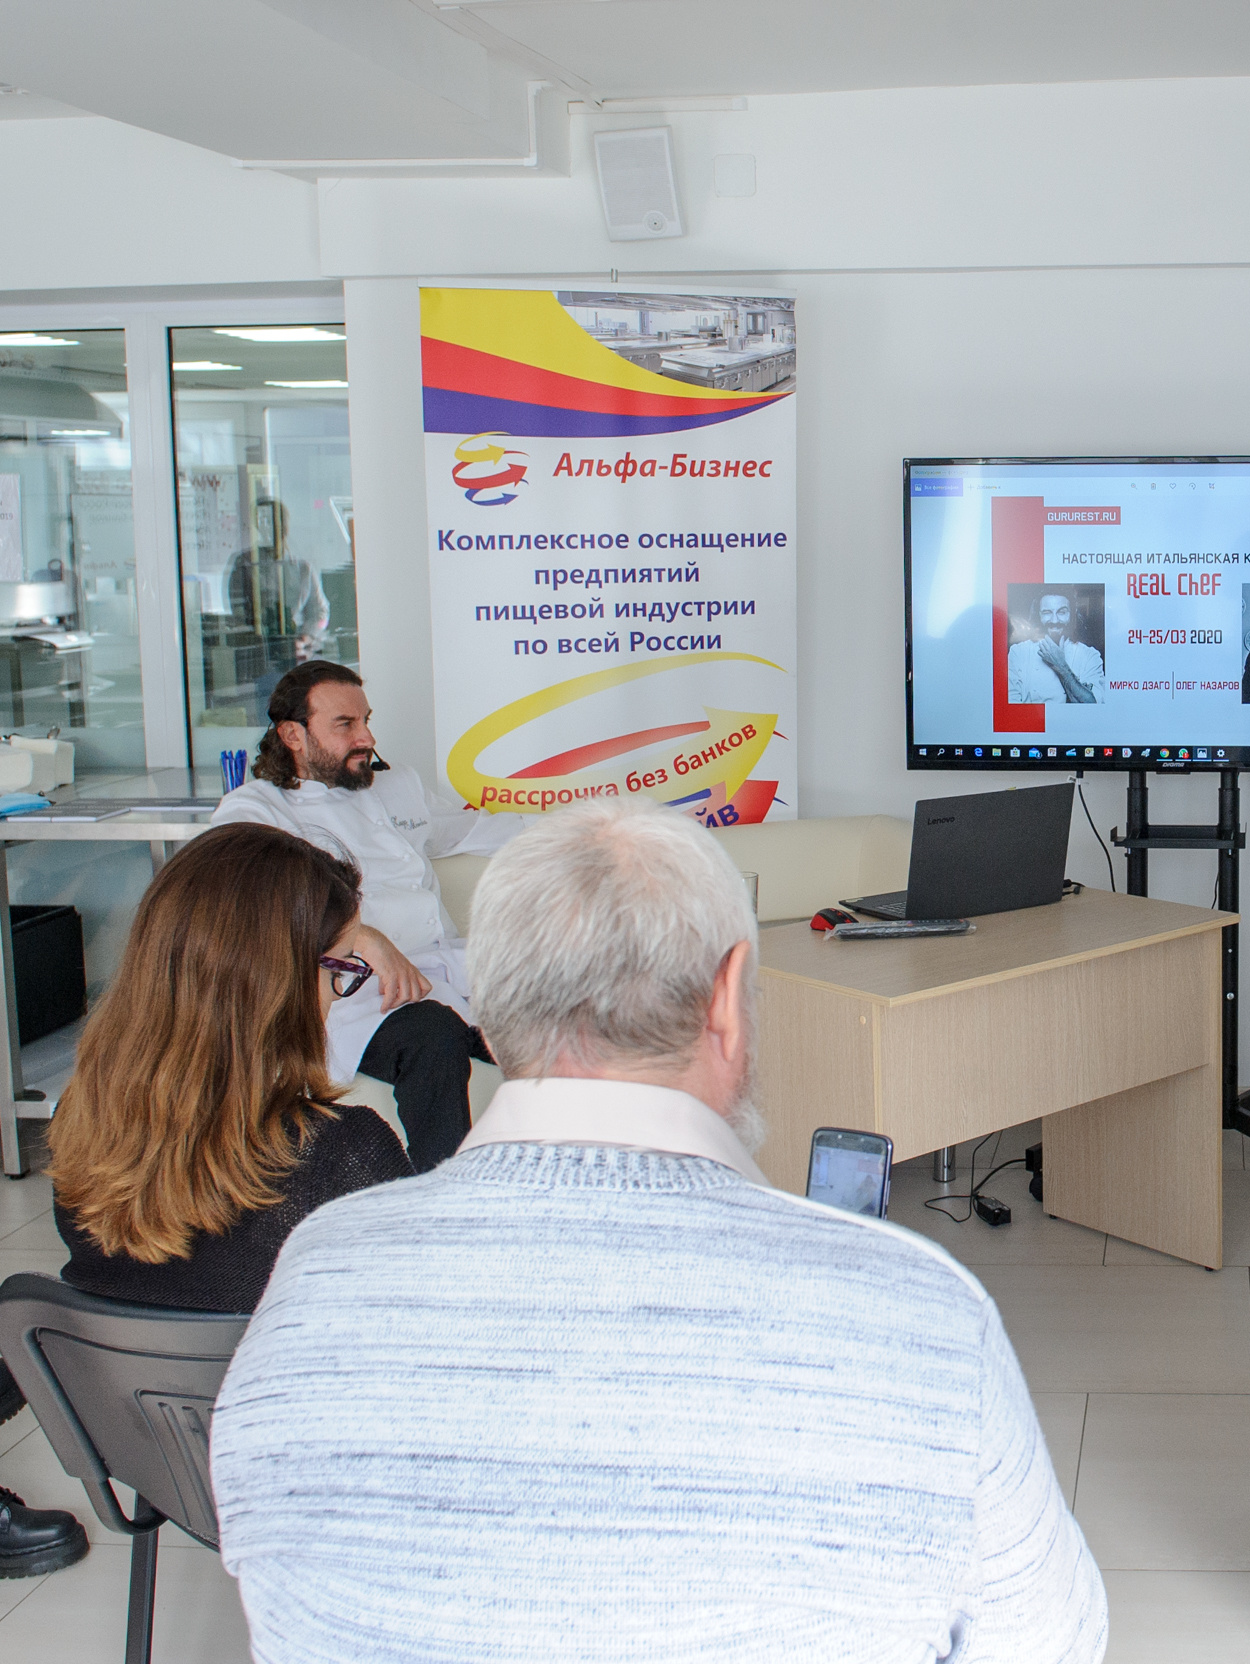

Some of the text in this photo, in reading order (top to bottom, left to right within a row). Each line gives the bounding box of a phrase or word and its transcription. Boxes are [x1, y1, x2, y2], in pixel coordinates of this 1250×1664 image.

[553, 452, 773, 484] Альфа-Бизнес
[1047, 511, 1117, 522] GURUREST.RU
[437, 529, 788, 553] Комплексное оснащение
[1062, 553, 1142, 566] НАСТОЯЩАЯ
[1146, 553, 1240, 564] ИТАЛЬЯНСКАЯ
[534, 562, 700, 591] предпиятий
[475, 597, 757, 625] пищевой индустрии
[513, 630, 722, 655] по всей России
[1128, 629, 1223, 645] 24-25/03 2020
[1109, 681, 1240, 691] МИРКО ДЗАГО ОЛЕГ НАЗАРОВ
[480, 722, 758, 811] рассрочка без банков
[927, 816, 956, 826] Lenovo
